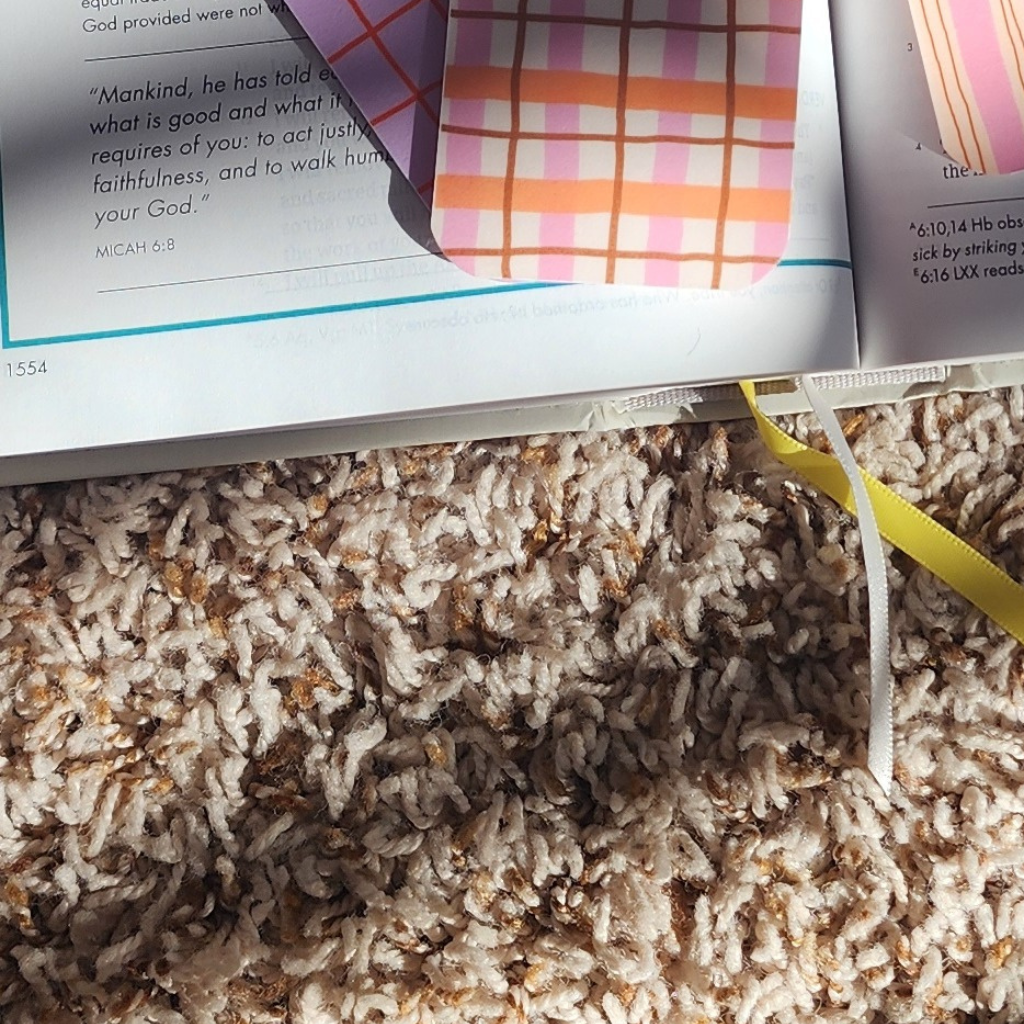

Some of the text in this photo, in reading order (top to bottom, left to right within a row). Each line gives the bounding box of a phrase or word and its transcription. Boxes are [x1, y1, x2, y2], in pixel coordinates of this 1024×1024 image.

[82, 15, 116, 32] God
[124, 7, 190, 33] provided
[196, 9, 234, 21] were
[239, 2, 261, 17] not
[89, 76, 193, 105] “Mankind,
[202, 74, 225, 94] he
[234, 70, 267, 90] has
[275, 63, 311, 86] told
[89, 92, 344, 134] what is good and what it
[91, 125, 312, 167] requires of you: to act
[93, 149, 335, 193] faithfulness, and to walk
[94, 193, 209, 229] your God.”
[971, 216, 993, 232] Hb
[95, 237, 174, 258] MICAH 6:8
[913, 245, 938, 261] sick
[943, 242, 960, 259] by
[965, 238, 1017, 256] striking
[953, 266, 980, 279] LXX
[984, 263, 1024, 277] reads
[6, 359, 47, 377] 1554
